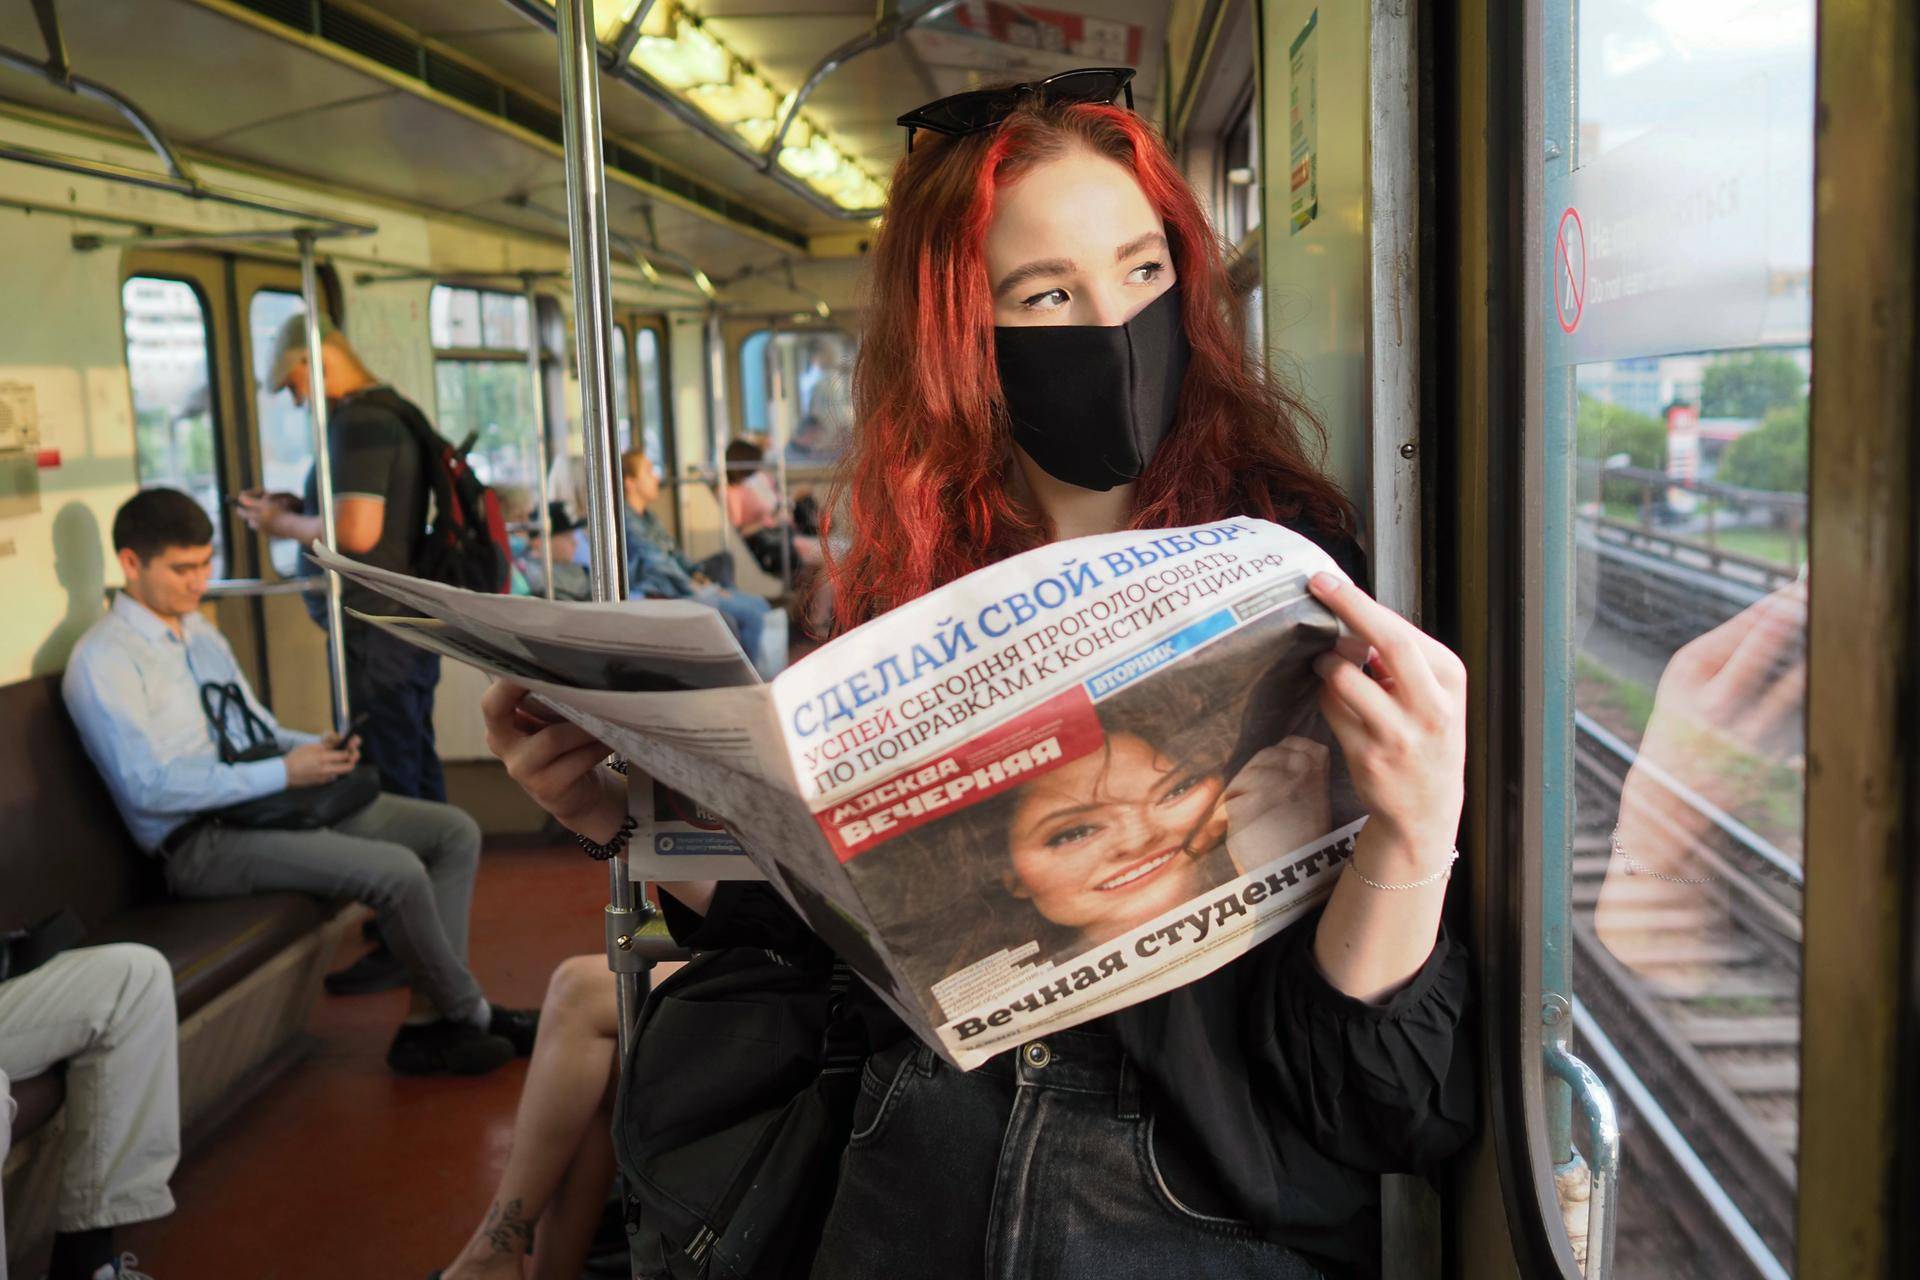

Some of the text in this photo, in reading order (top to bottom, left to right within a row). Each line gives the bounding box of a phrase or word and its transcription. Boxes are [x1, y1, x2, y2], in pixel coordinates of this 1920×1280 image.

[793, 523, 1256, 737] СДЕЛАЙ СВОЙ ВЫБОР!
[803, 706, 899, 770] УСПЕЙ
[900, 645, 1023, 720] СЕГОДНЯ
[1023, 552, 1238, 655] ПРОГОЛОСОВАТЬ
[814, 761, 855, 794] ПО
[856, 670, 1033, 772] ПОПРАВКАМ
[1032, 655, 1056, 680] К
[1054, 564, 1252, 668] КОНСТИТУЦИИ
[1249, 552, 1284, 574] РФ
[1091, 639, 1176, 694] ВТОРНИК
[831, 757, 961, 825] МОСКВА
[838, 736, 1063, 847] ВЕЧЕРНЯЯ
[952, 950, 1128, 1041] Вечная
[1134, 831, 1360, 958] студентк
